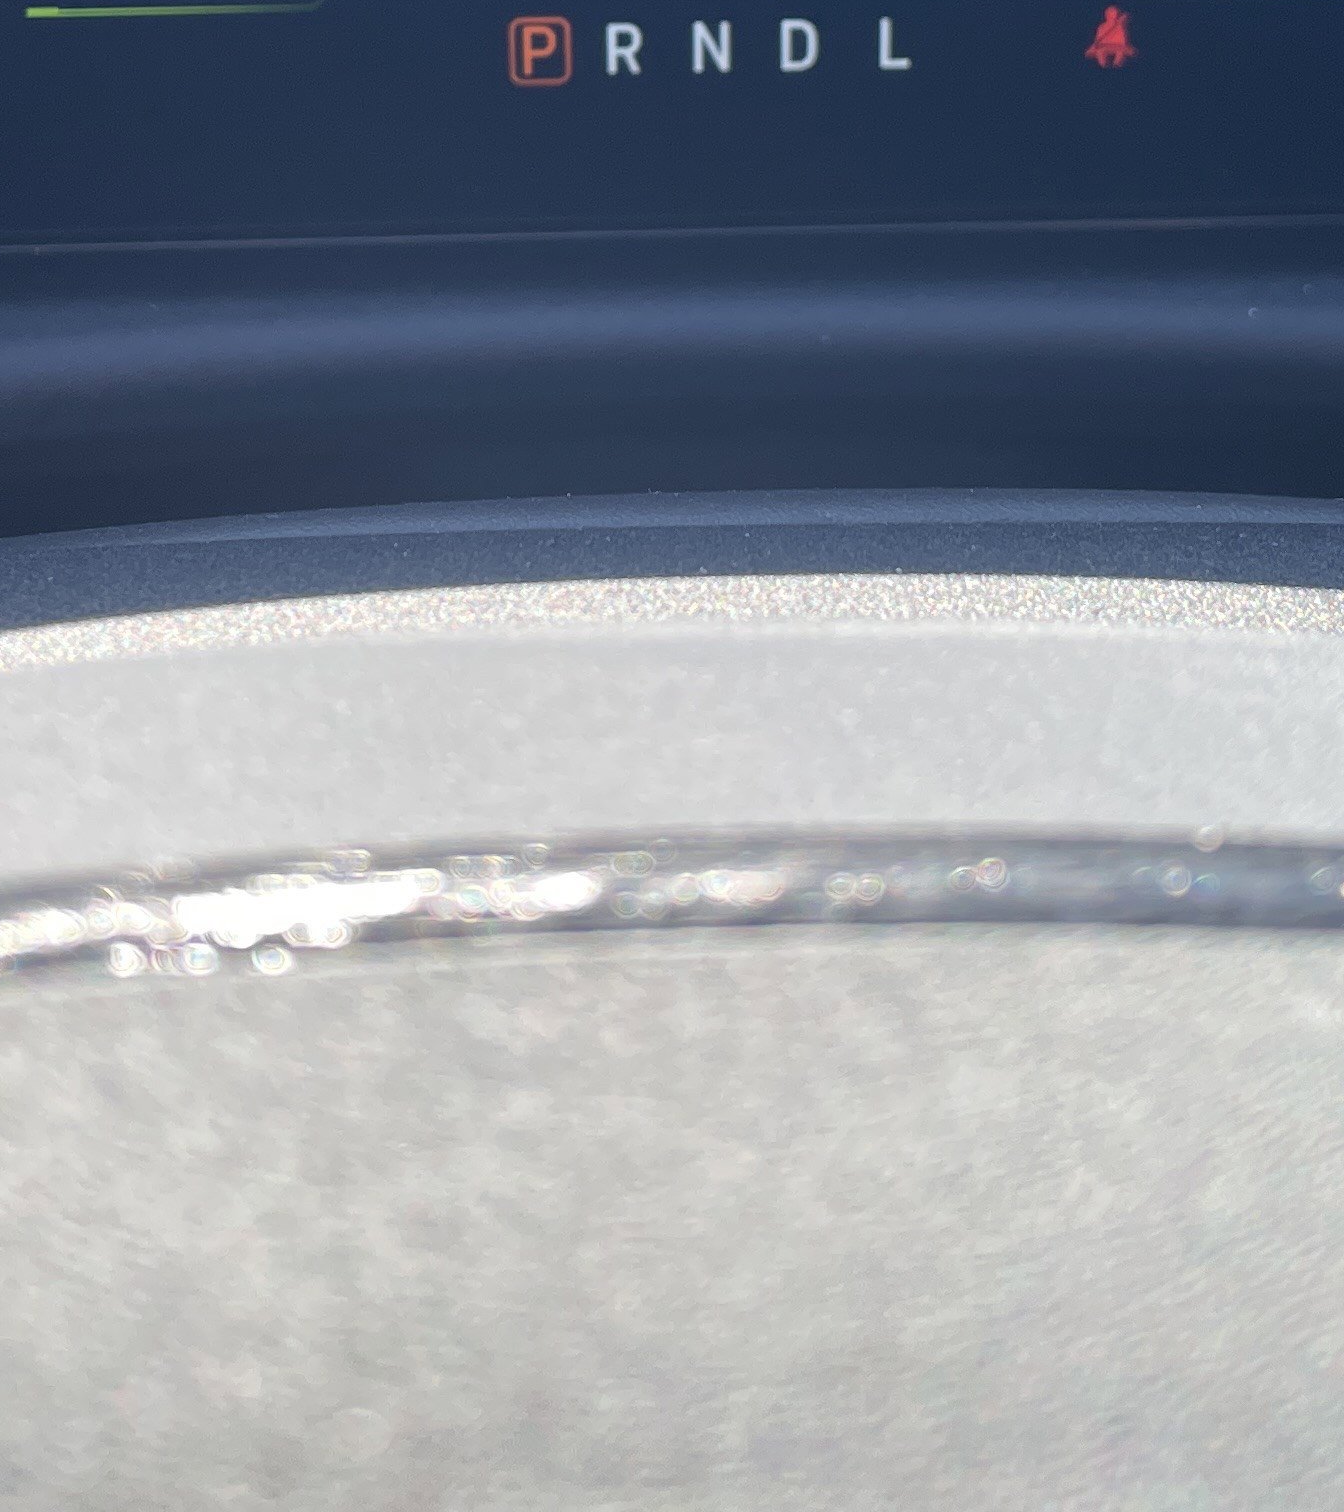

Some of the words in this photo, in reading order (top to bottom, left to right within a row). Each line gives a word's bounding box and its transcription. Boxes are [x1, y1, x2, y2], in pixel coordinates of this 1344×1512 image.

[521, 26, 557, 76] P
[605, 23, 642, 73] R
[691, 21, 733, 71] N
[779, 19, 820, 71] D
[878, 18, 912, 70] L
